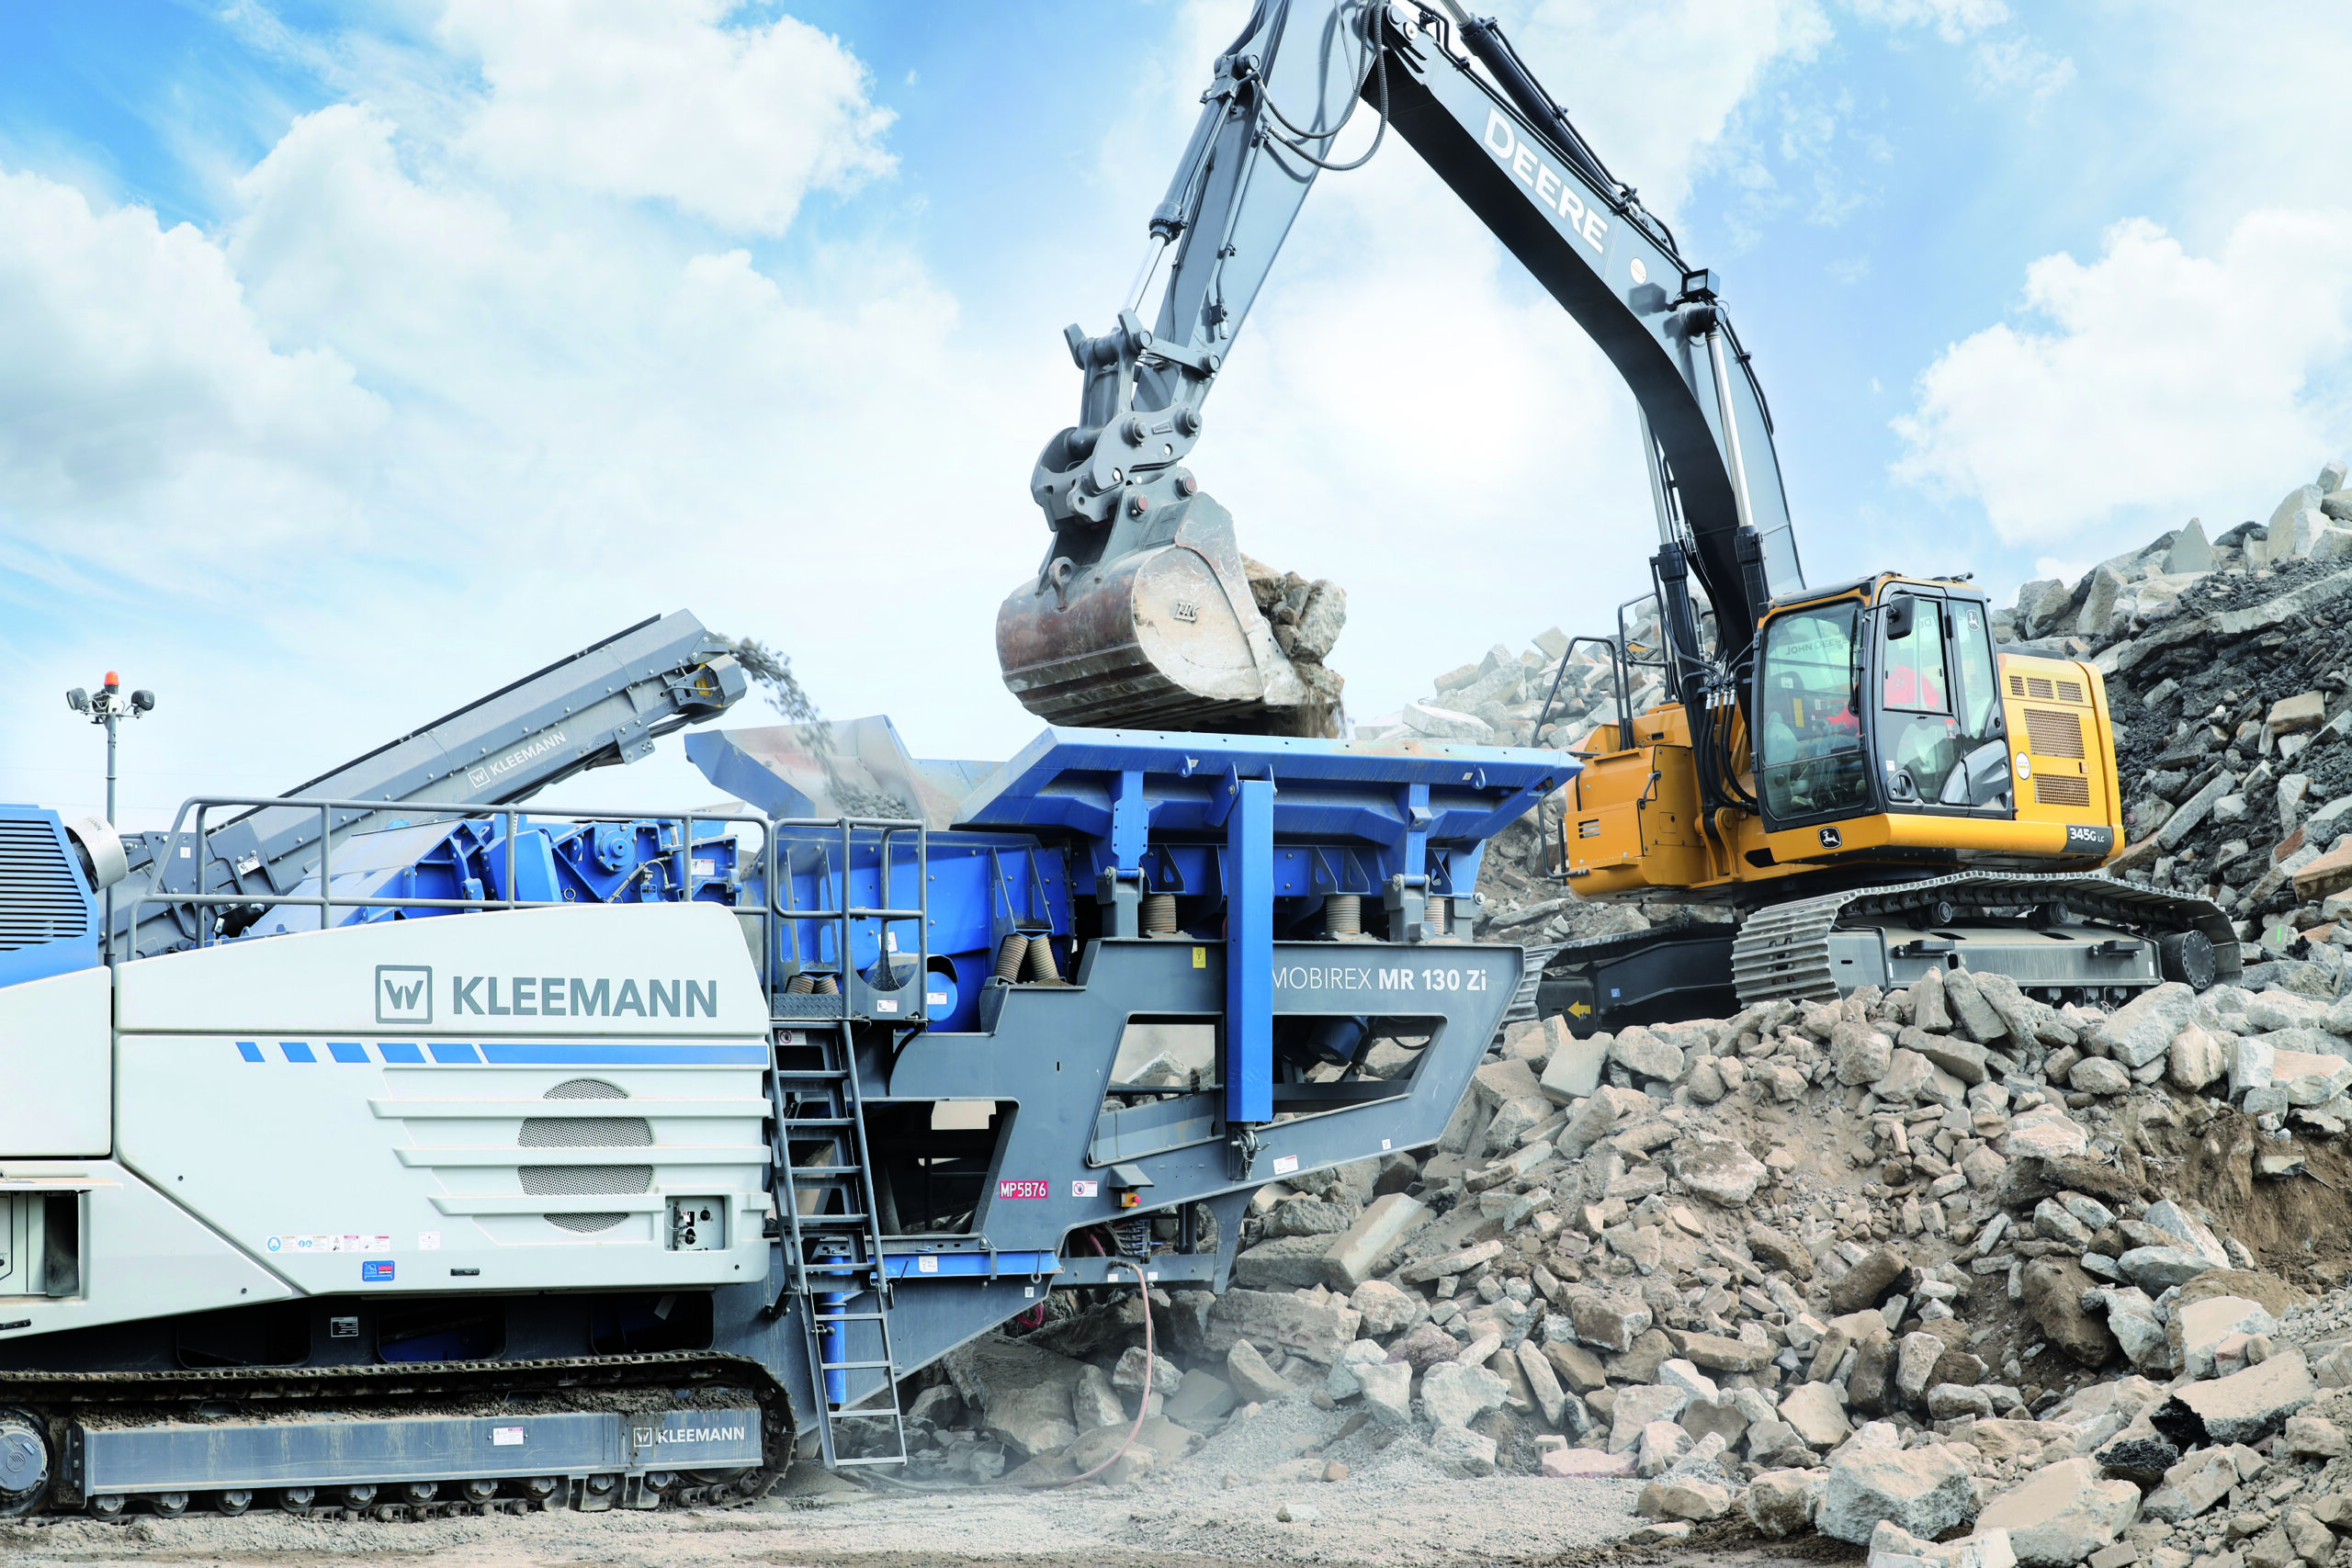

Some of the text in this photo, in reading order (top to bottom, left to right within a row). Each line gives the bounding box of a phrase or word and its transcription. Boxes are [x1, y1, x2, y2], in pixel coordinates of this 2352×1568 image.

[1484, 107, 1608, 254] DEERE
[1785, 643, 1813, 655] JOHN
[489, 731, 567, 776] KLEEMANN
[2069, 828, 2097, 842] 345G
[1272, 966, 1487, 991] MOBIREX MR 130 Zi
[453, 976, 717, 1018] KLEEMANN
[1001, 1182, 1046, 1198] MP5B76
[658, 1427, 745, 1444] KLEEMANN
